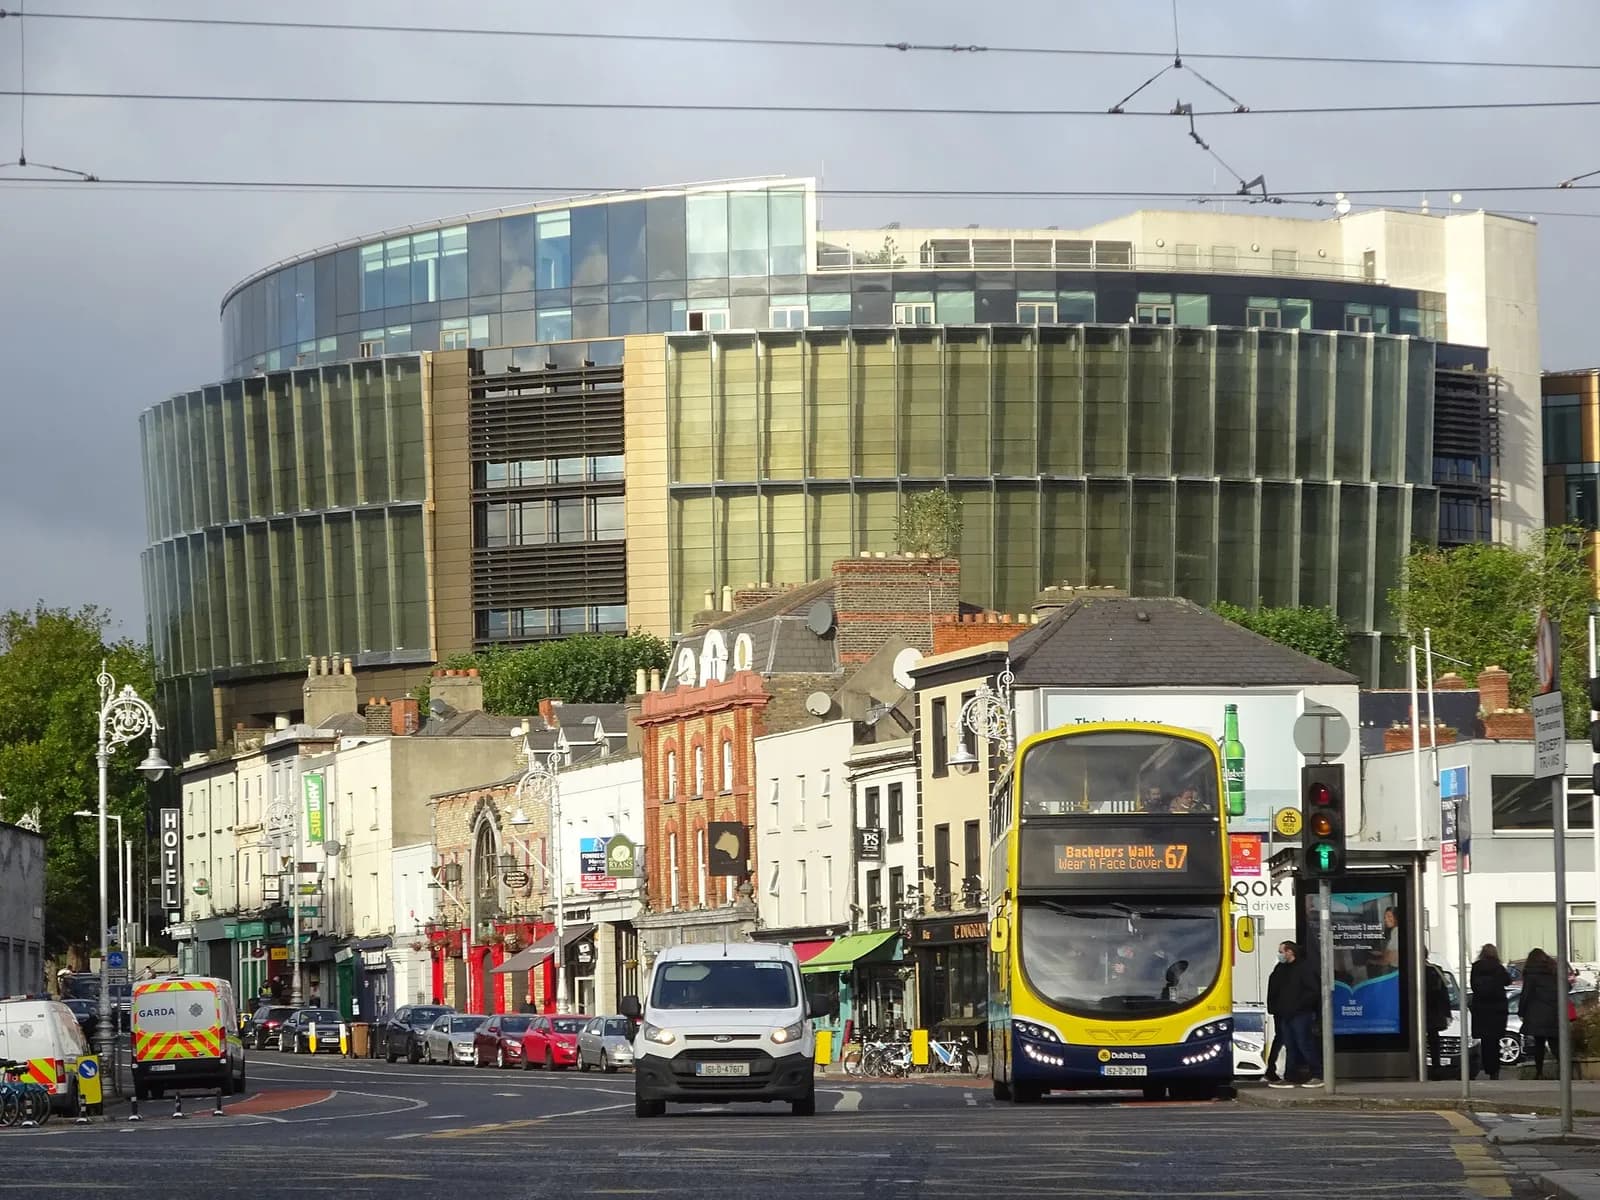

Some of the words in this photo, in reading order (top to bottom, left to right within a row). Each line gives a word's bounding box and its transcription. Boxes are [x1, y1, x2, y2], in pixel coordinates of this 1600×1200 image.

[1538, 737, 1562, 753] EXCEPT
[307, 779, 322, 838] SUBWAY
[863, 832, 879, 846] PS
[164, 812, 178, 905] HOTEL
[1066, 845, 1124, 858] Bachelors
[1128, 844, 1155, 858] Walk
[1165, 844, 1188, 869] 67
[1058, 858, 1086, 870] Wear
[1089, 858, 1096, 870] A
[1100, 858, 1126, 870] Face
[1129, 858, 1163, 870] Cover
[1234, 881, 1282, 896] OOK
[1252, 901, 1290, 911] drives
[138, 1007, 175, 1018] GARDA
[1111, 1051, 1132, 1059] Dublin
[1132, 1051, 1146, 1059] Bus
